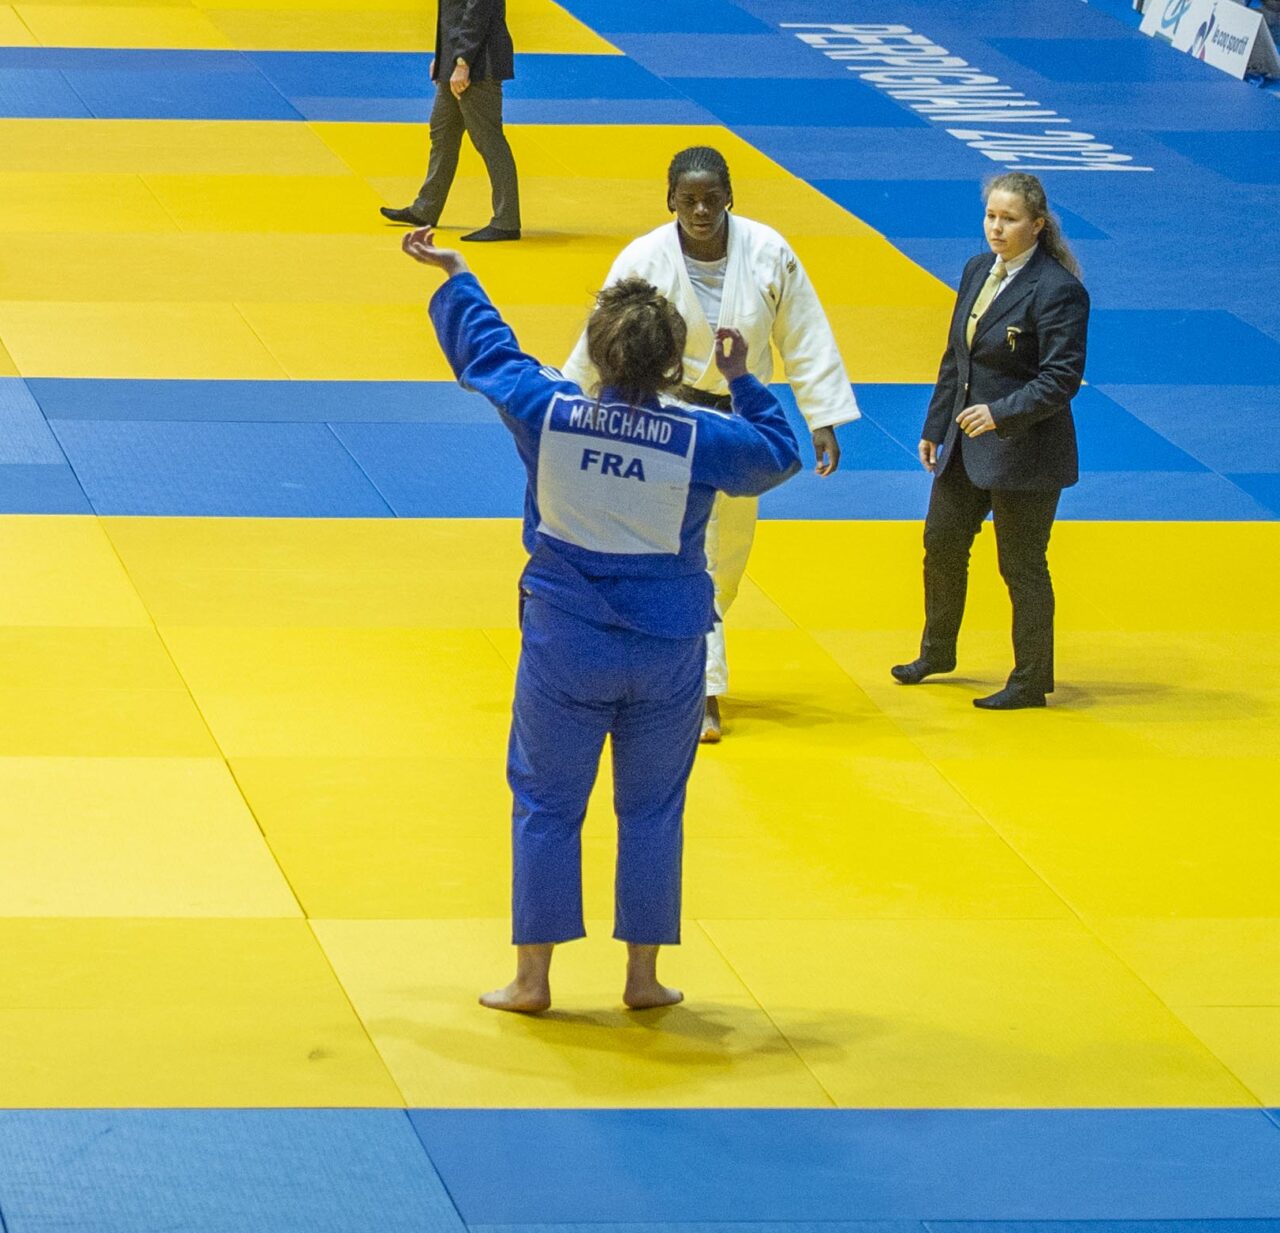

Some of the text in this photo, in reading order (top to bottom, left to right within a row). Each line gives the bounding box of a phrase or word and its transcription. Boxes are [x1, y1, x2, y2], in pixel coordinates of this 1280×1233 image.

[779, 23, 1154, 171] PERPIGNAN 2021
[569, 405, 672, 444] MARCHAND
[580, 448, 646, 482] FRA
